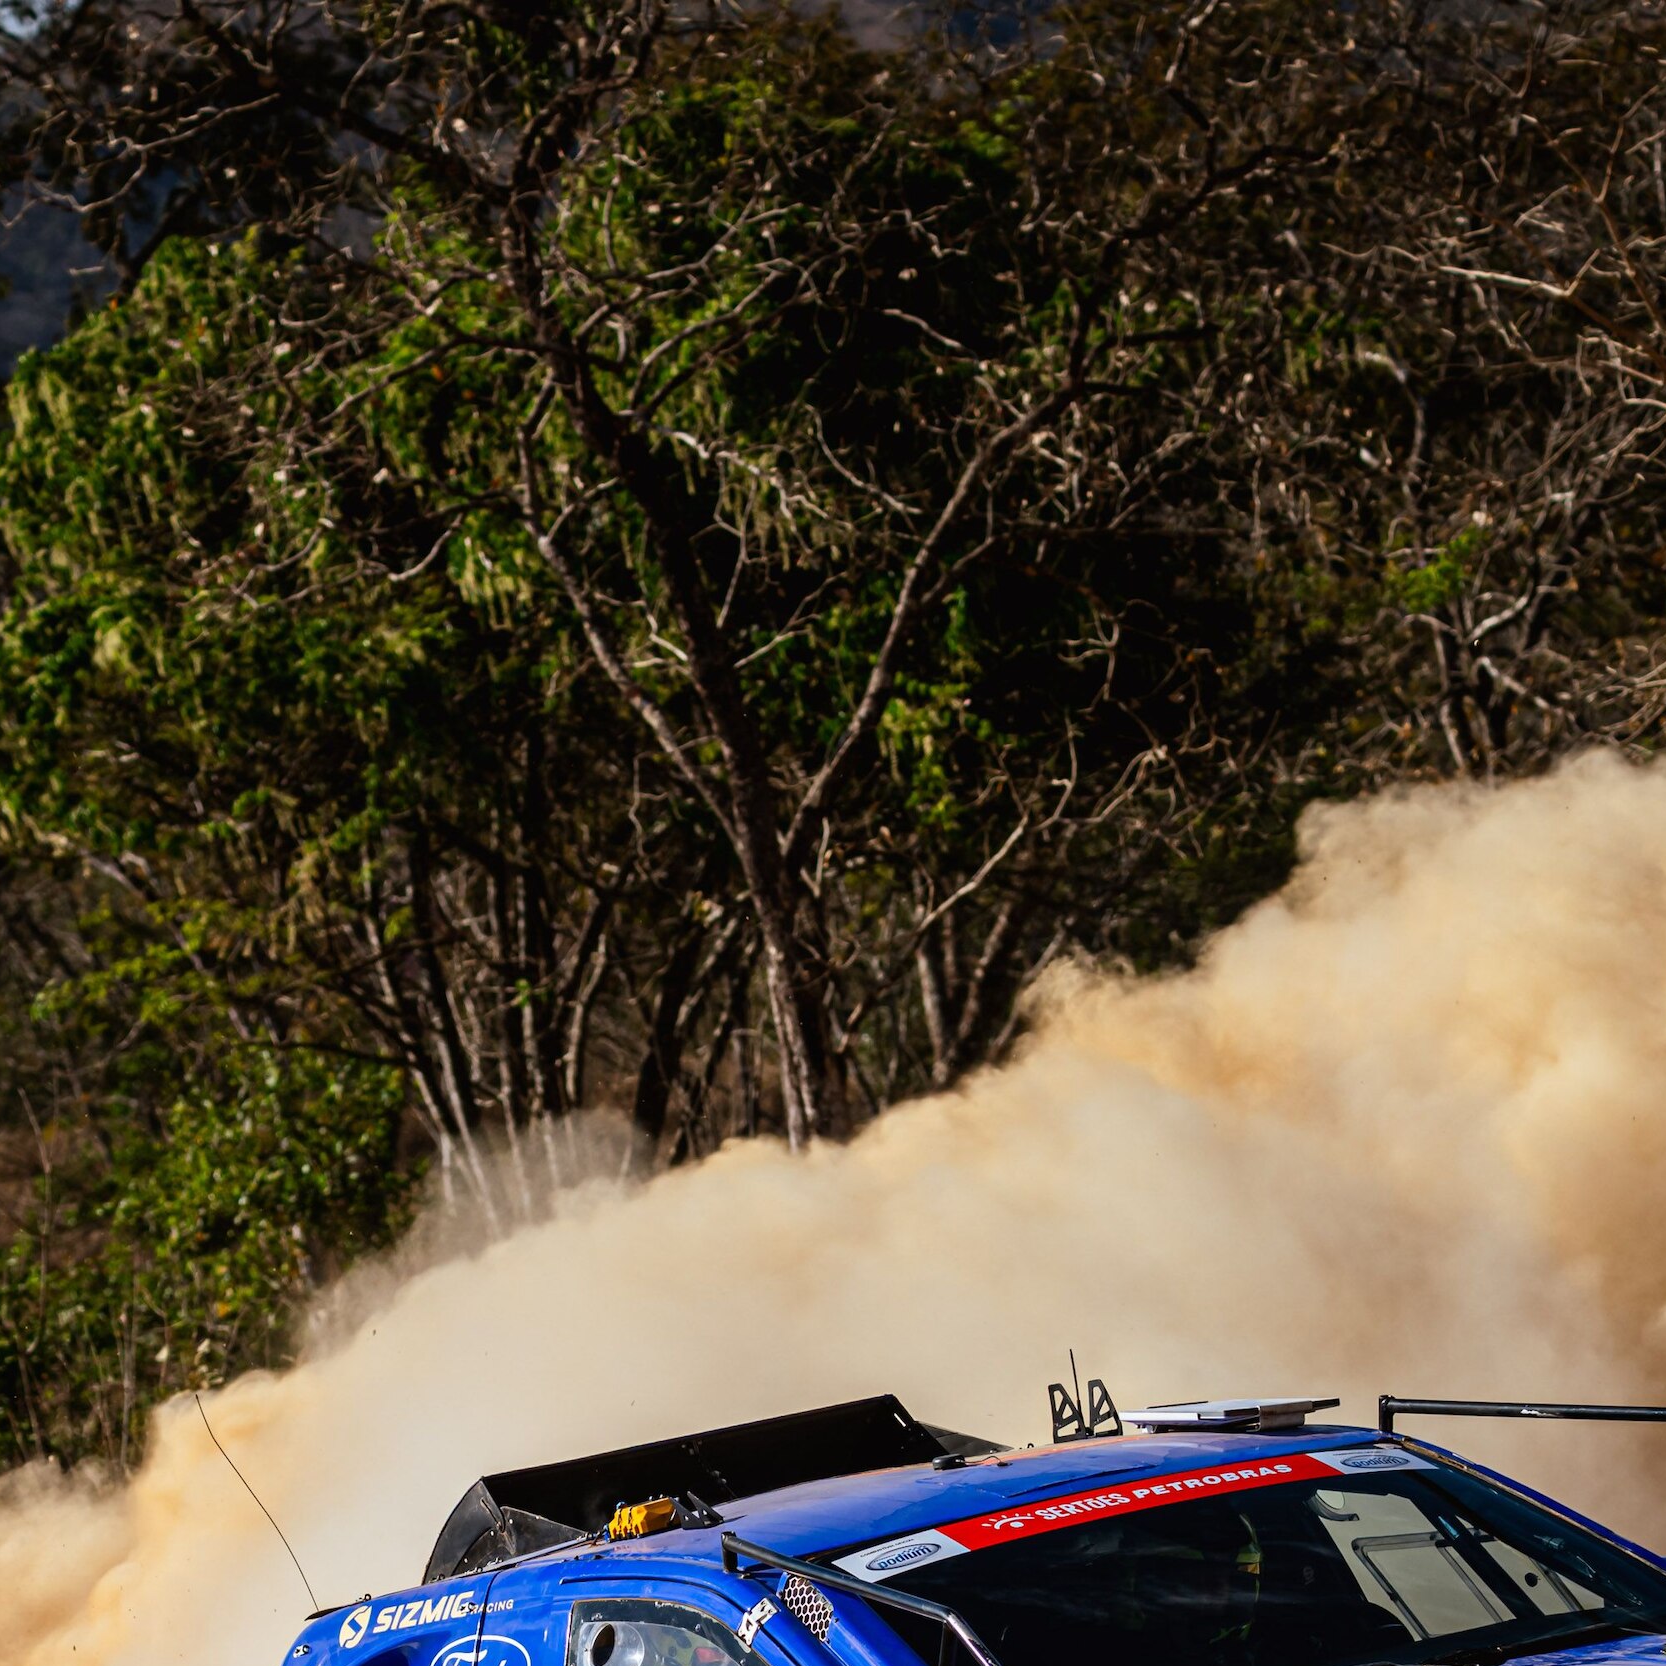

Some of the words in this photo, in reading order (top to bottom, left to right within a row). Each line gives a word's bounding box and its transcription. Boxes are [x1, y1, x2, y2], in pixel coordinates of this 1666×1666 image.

[1034, 1493, 1131, 1520] SERTÕES
[1132, 1464, 1293, 1499] PETROBRAS
[877, 1545, 932, 1569] podium
[372, 1591, 474, 1634] SIZMIC
